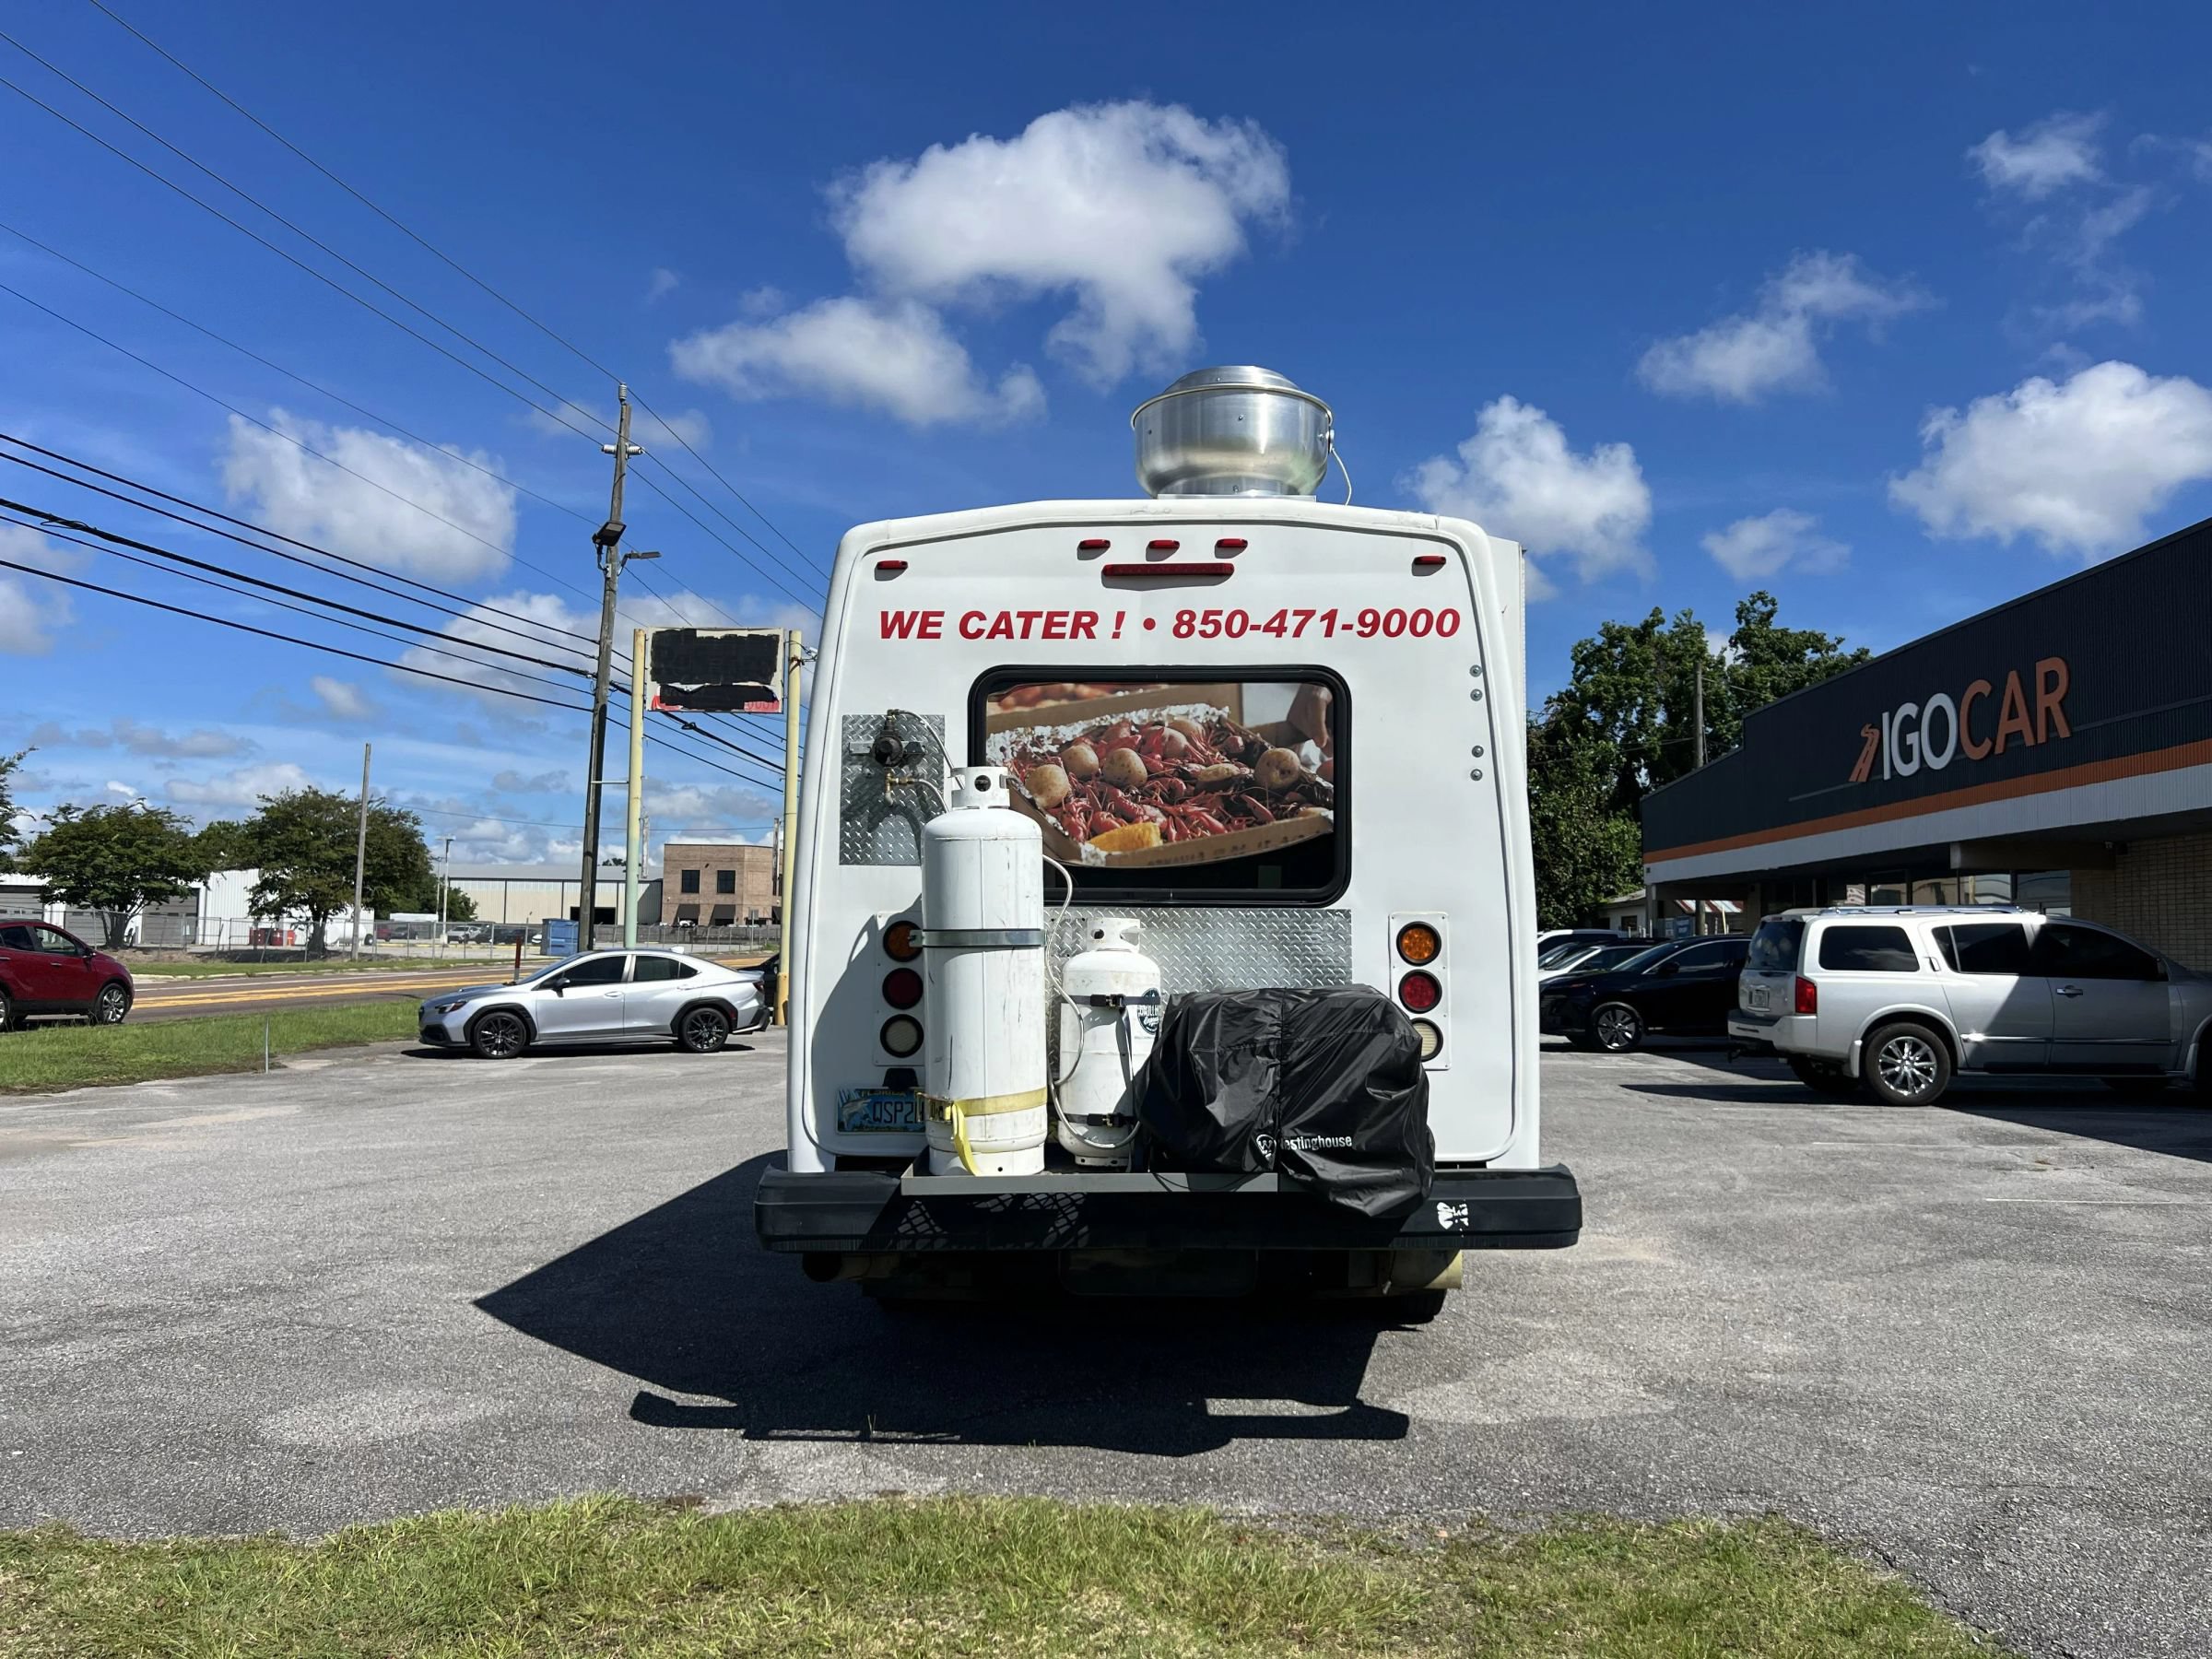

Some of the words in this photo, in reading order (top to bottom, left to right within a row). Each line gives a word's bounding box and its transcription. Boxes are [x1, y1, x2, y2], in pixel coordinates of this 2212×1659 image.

[880, 610, 945, 640] WE
[959, 610, 1099, 640] CATER
[1172, 608, 1461, 639] 850-471-9000
